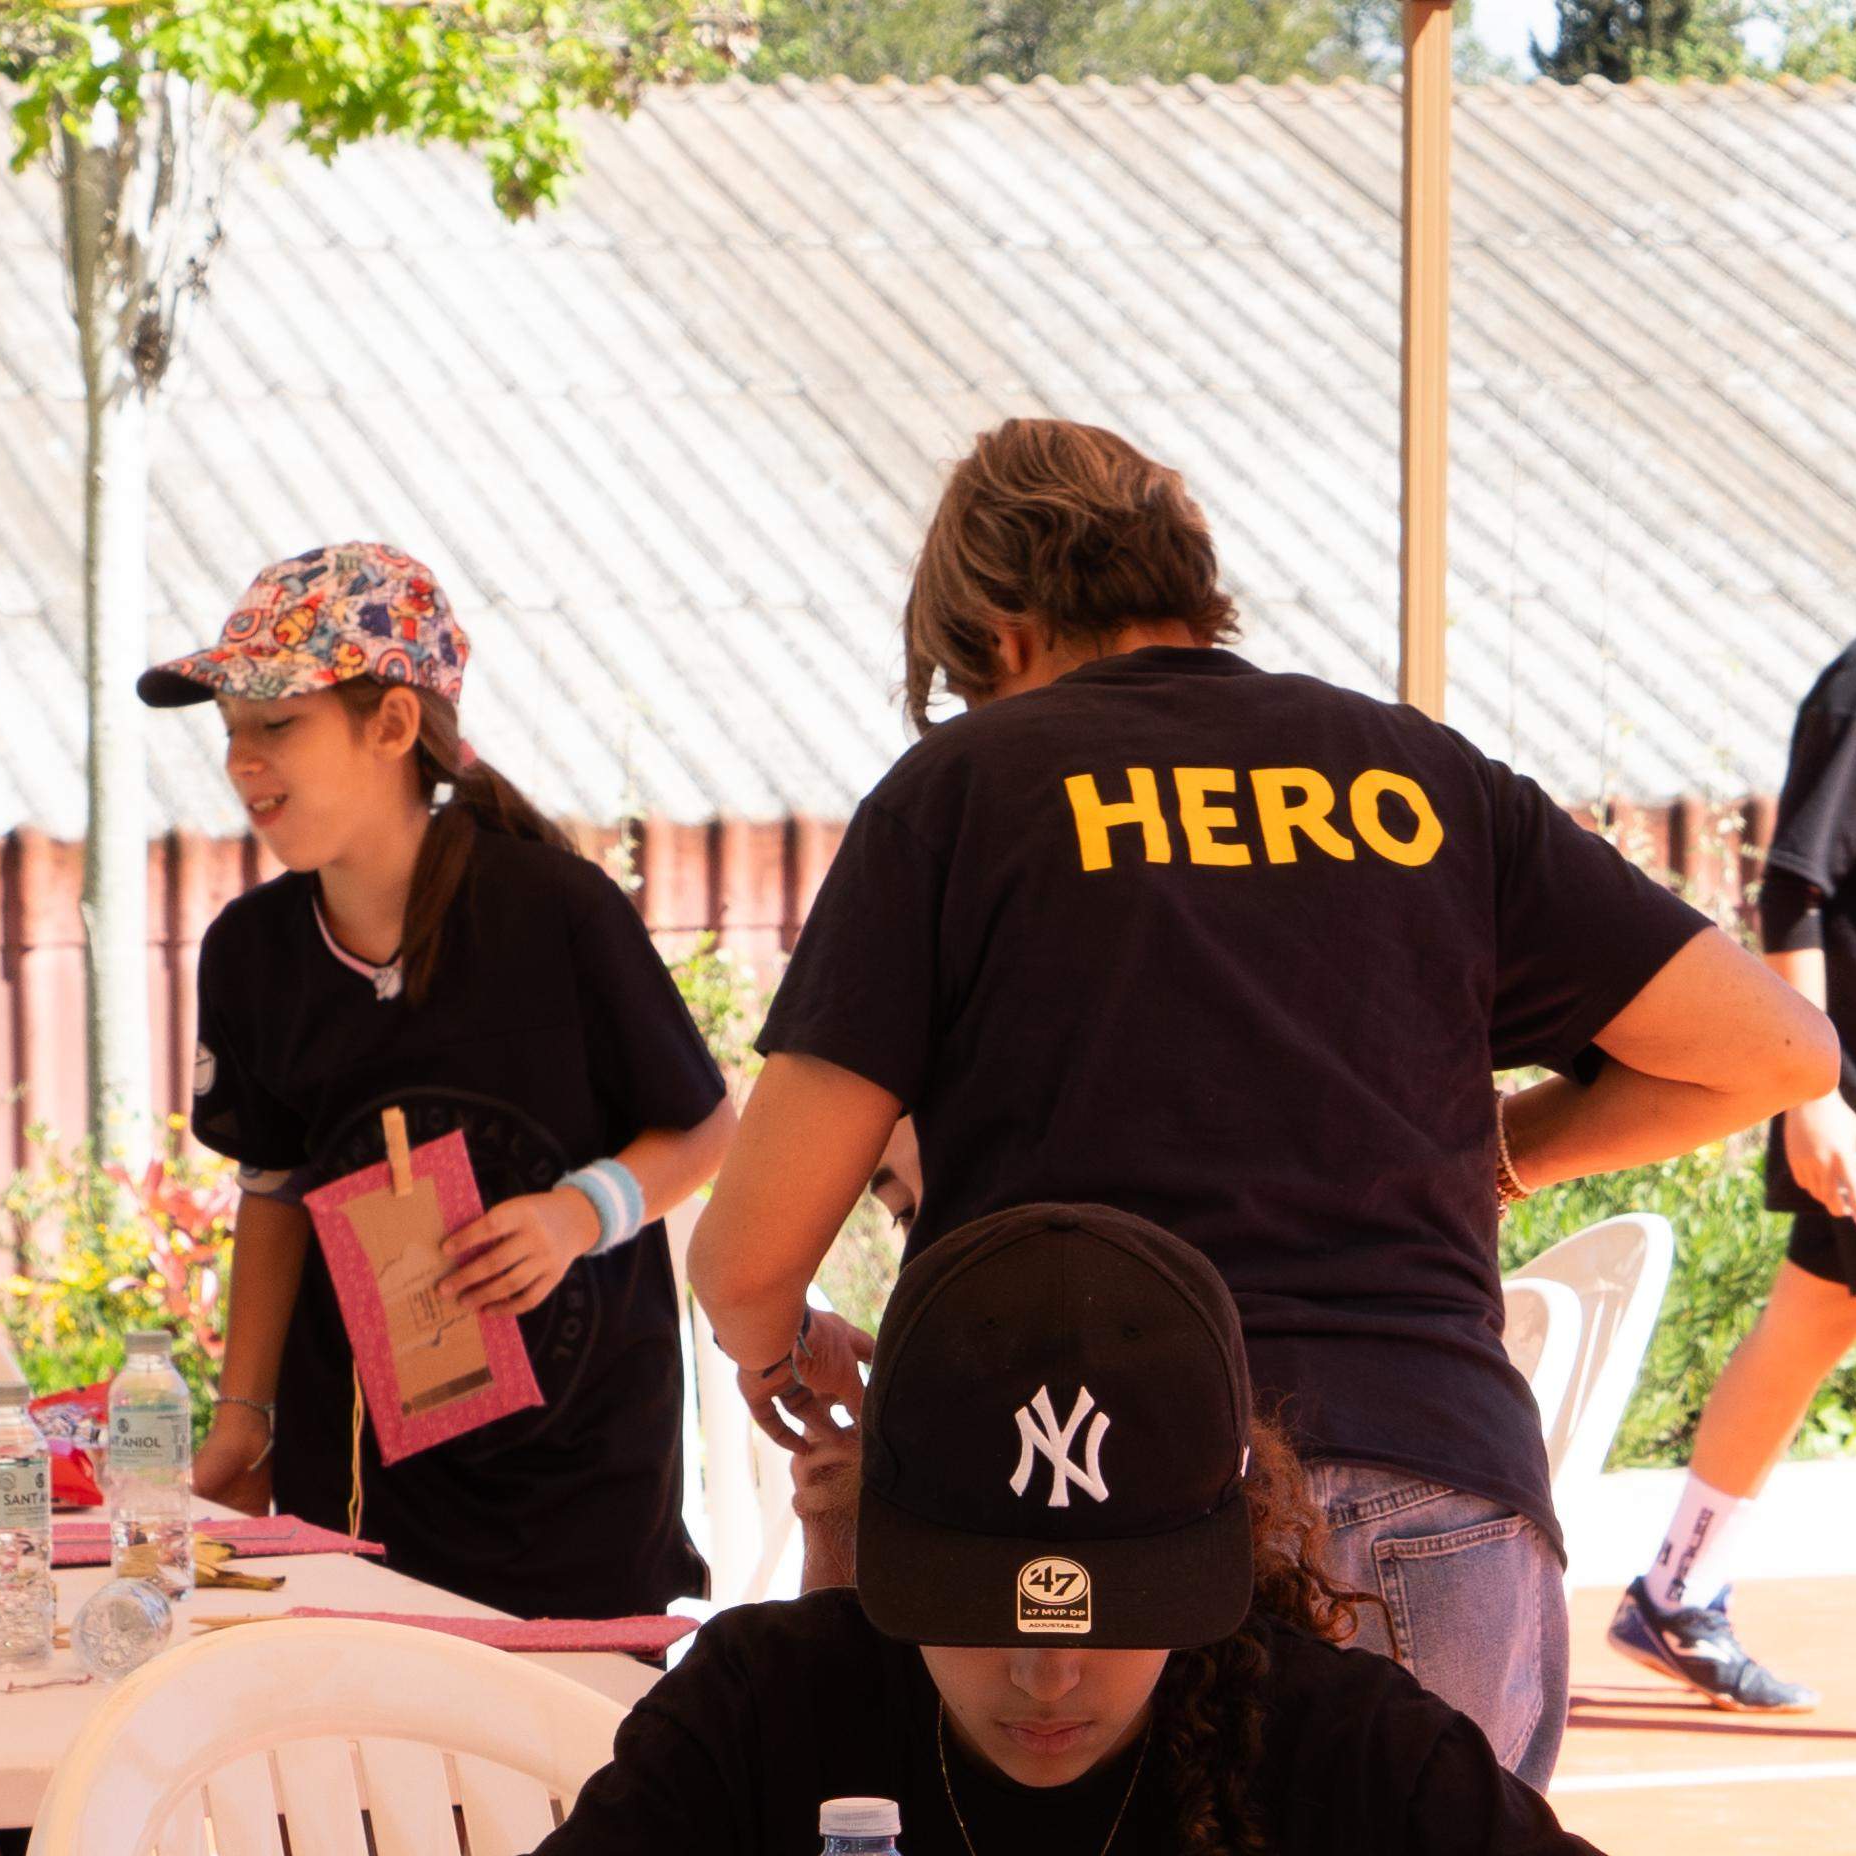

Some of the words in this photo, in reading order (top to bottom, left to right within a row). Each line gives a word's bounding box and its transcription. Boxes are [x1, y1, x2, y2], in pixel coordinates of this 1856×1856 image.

[1064, 767, 1444, 871] HERO
[122, 1436, 161, 1449] ANIOL
[1009, 1384, 1110, 1507] NY
[3, 1492, 38, 1506] SANT
[1041, 1608, 1067, 1616] MVP
[1069, 1609, 1086, 1617] DP
